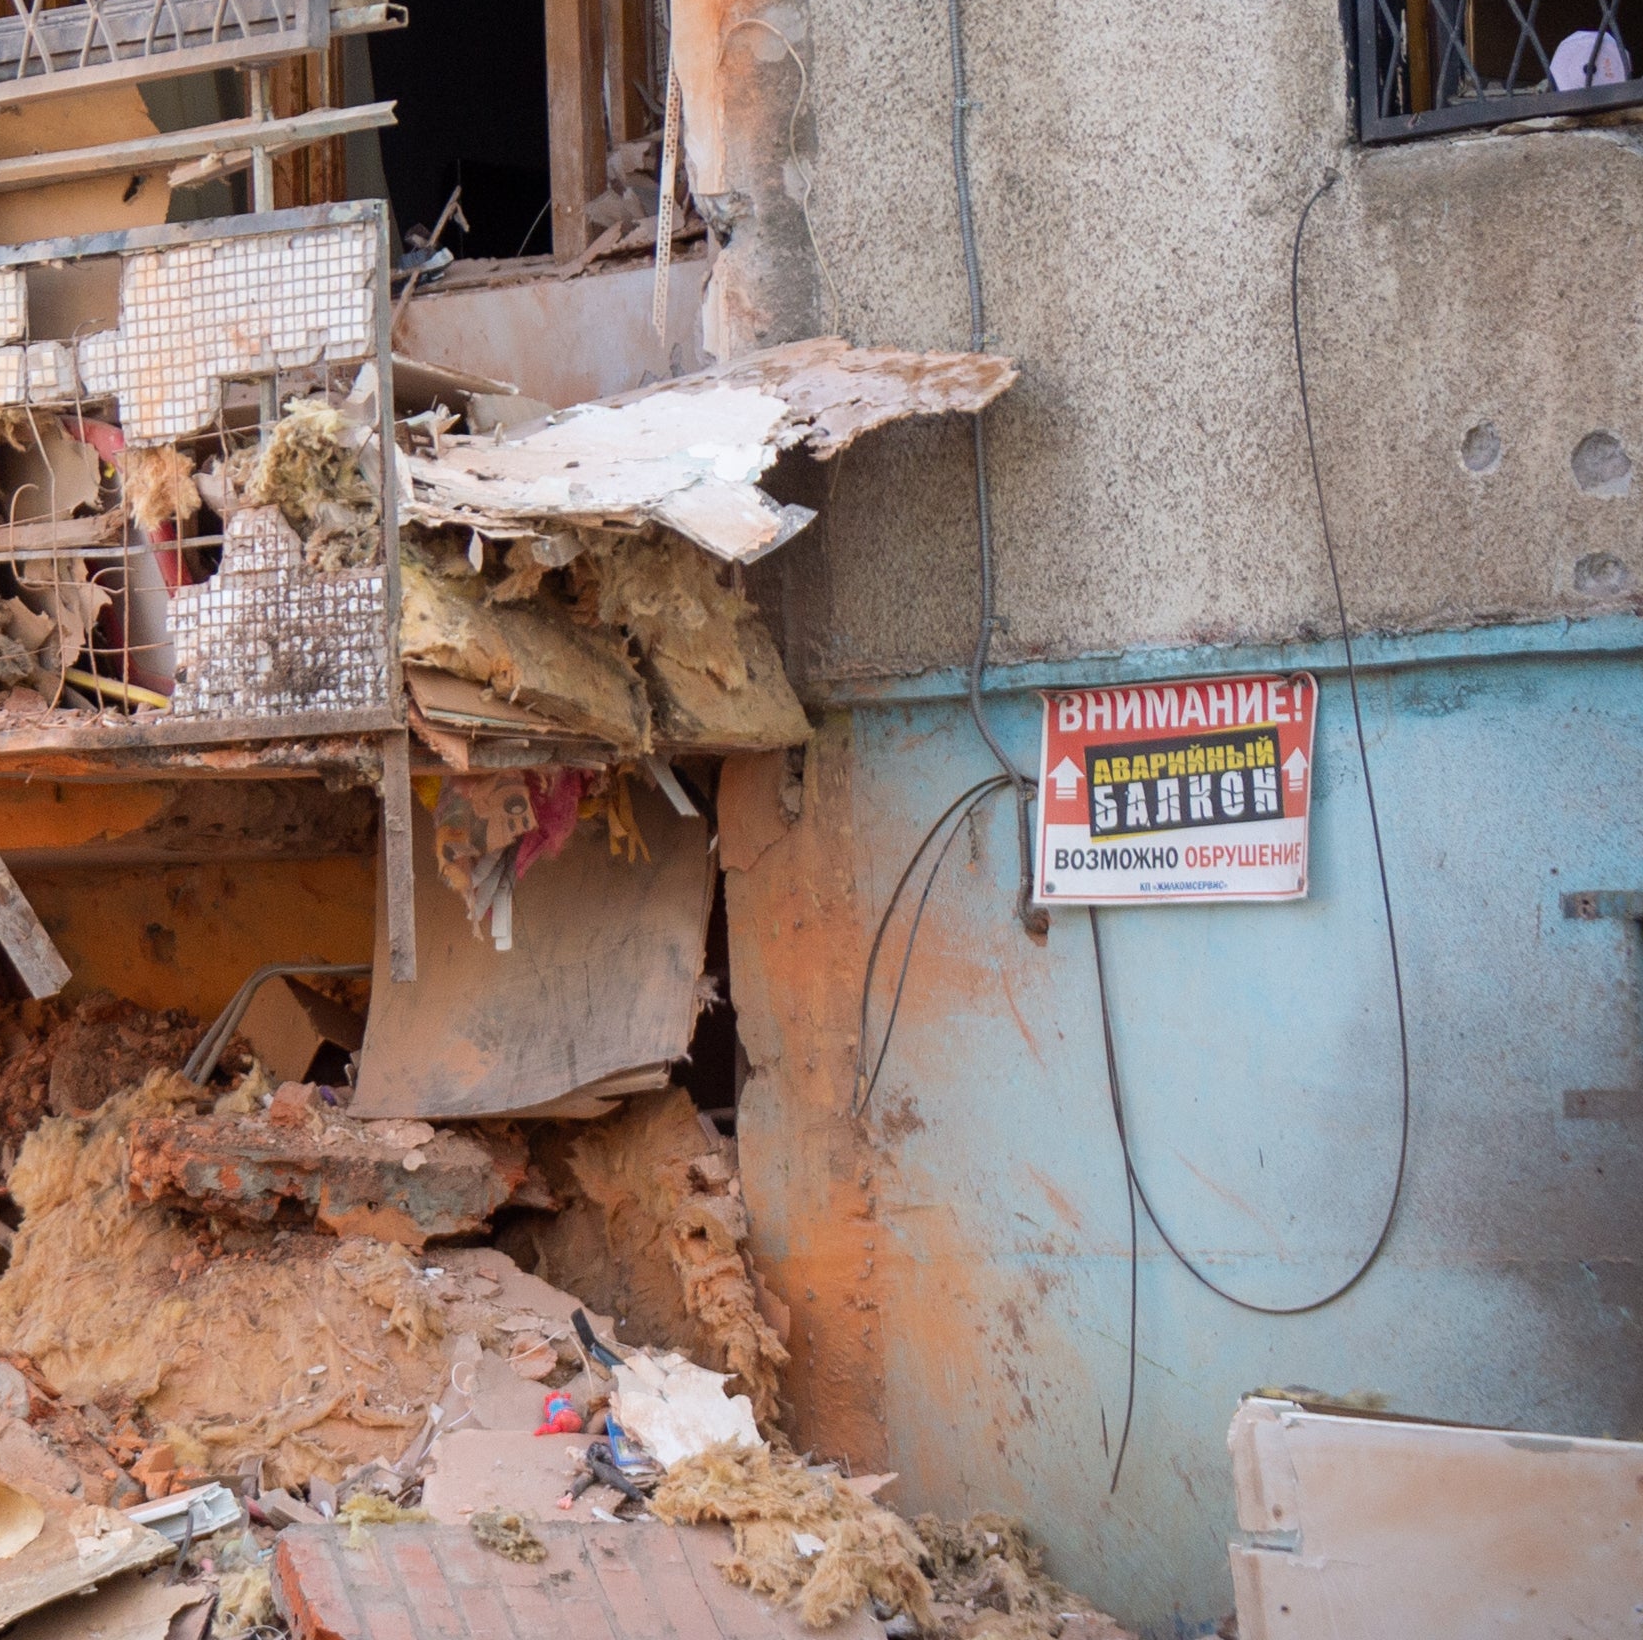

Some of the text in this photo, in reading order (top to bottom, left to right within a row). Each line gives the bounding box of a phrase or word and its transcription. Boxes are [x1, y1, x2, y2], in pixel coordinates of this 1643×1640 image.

[1059, 680, 1303, 732] ВНИМАНИЕ!
[1093, 735, 1276, 785] АВАРИЙНЫЙ
[1094, 767, 1278, 832] БАЛКОН
[1054, 841, 1303, 871] ВОЗМОЖНО ОБРУШЕНИЕ
[1139, 882, 1151, 891] КП
